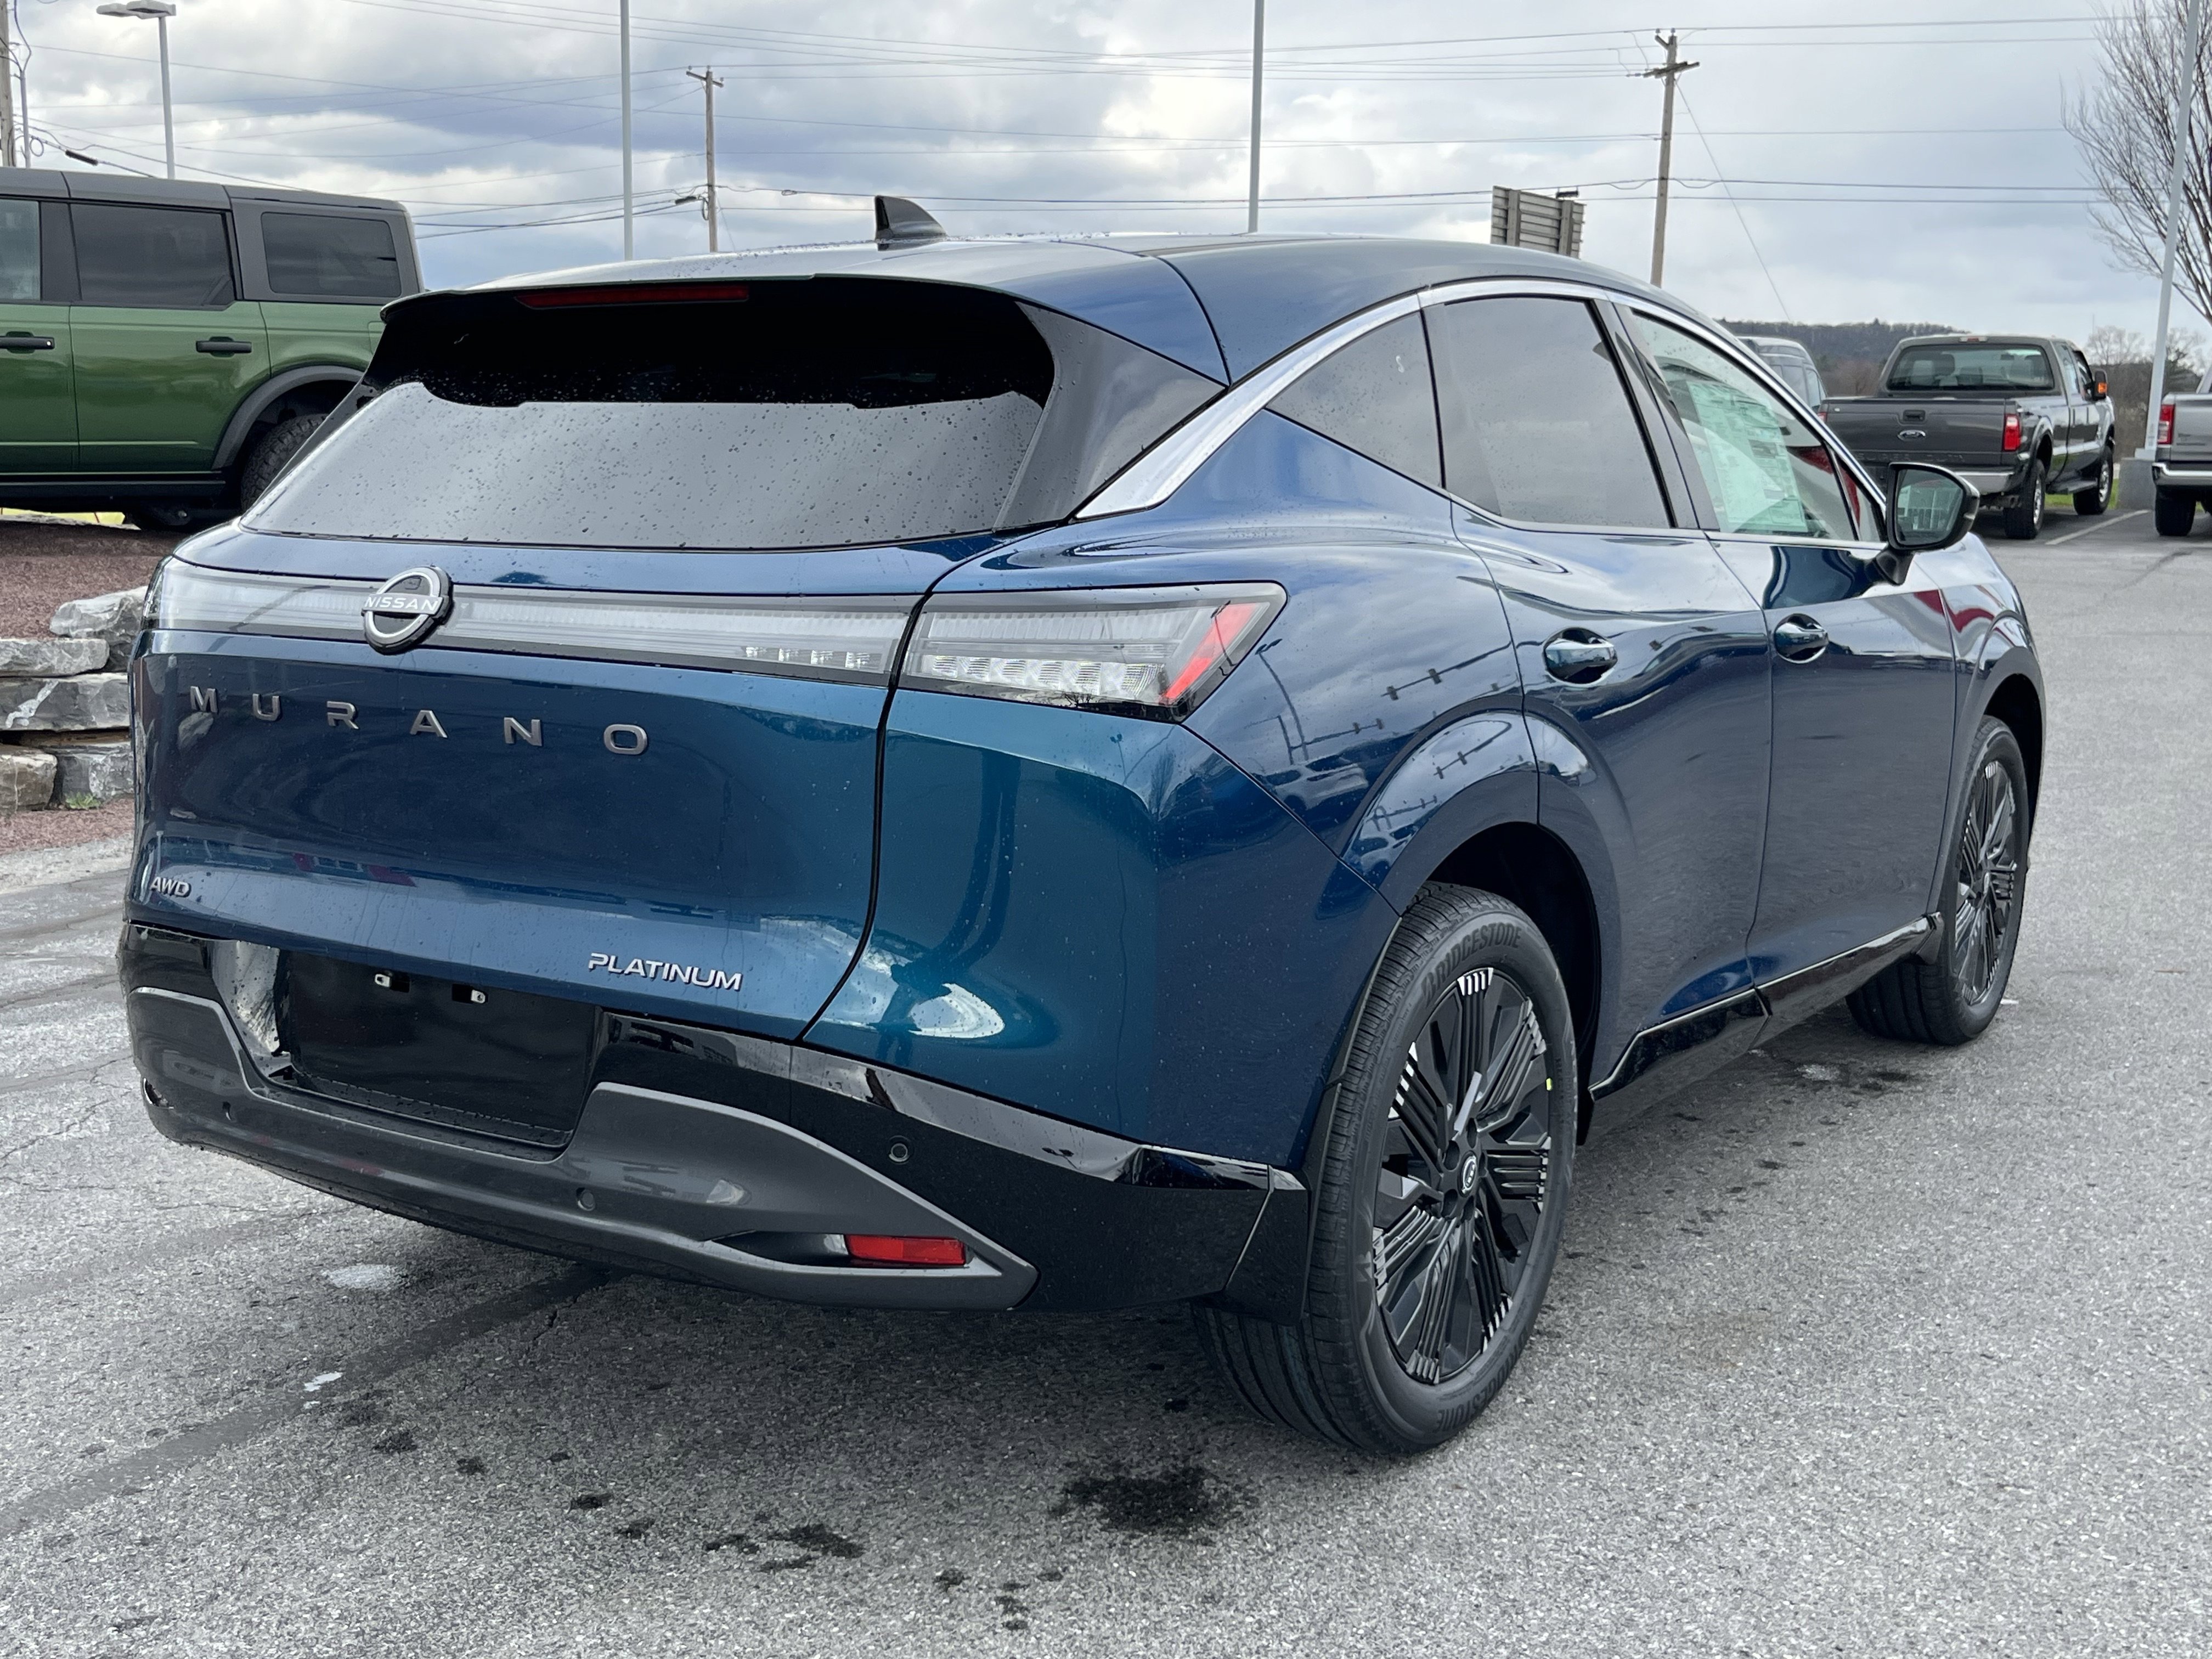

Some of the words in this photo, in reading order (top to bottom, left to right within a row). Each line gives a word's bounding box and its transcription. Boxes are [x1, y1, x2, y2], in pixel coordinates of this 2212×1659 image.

[364, 596, 438, 612] NISSAN
[190, 686, 648, 756] MURANO
[150, 877, 191, 897] AWD
[588, 952, 742, 991] PLATINUM
[1421, 922, 1522, 1008] BRIDGESTONE
